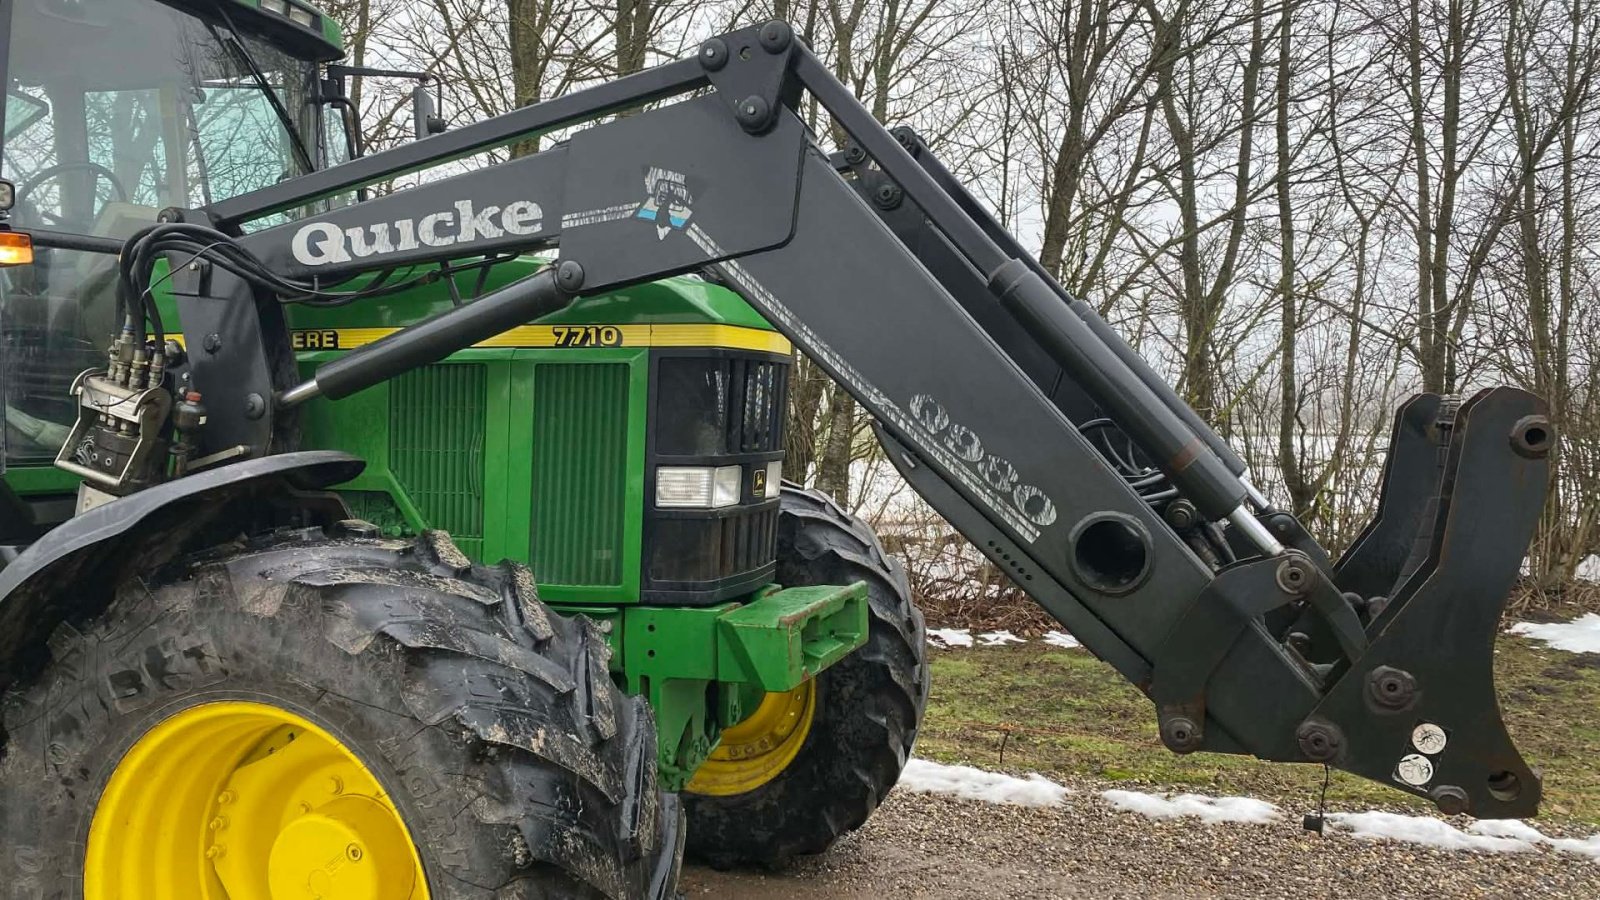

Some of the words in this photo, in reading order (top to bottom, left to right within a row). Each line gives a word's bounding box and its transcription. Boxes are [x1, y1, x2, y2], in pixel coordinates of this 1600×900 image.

[291, 199, 543, 266] Quicke
[292, 330, 338, 350] ERE
[553, 326, 622, 346] 7710
